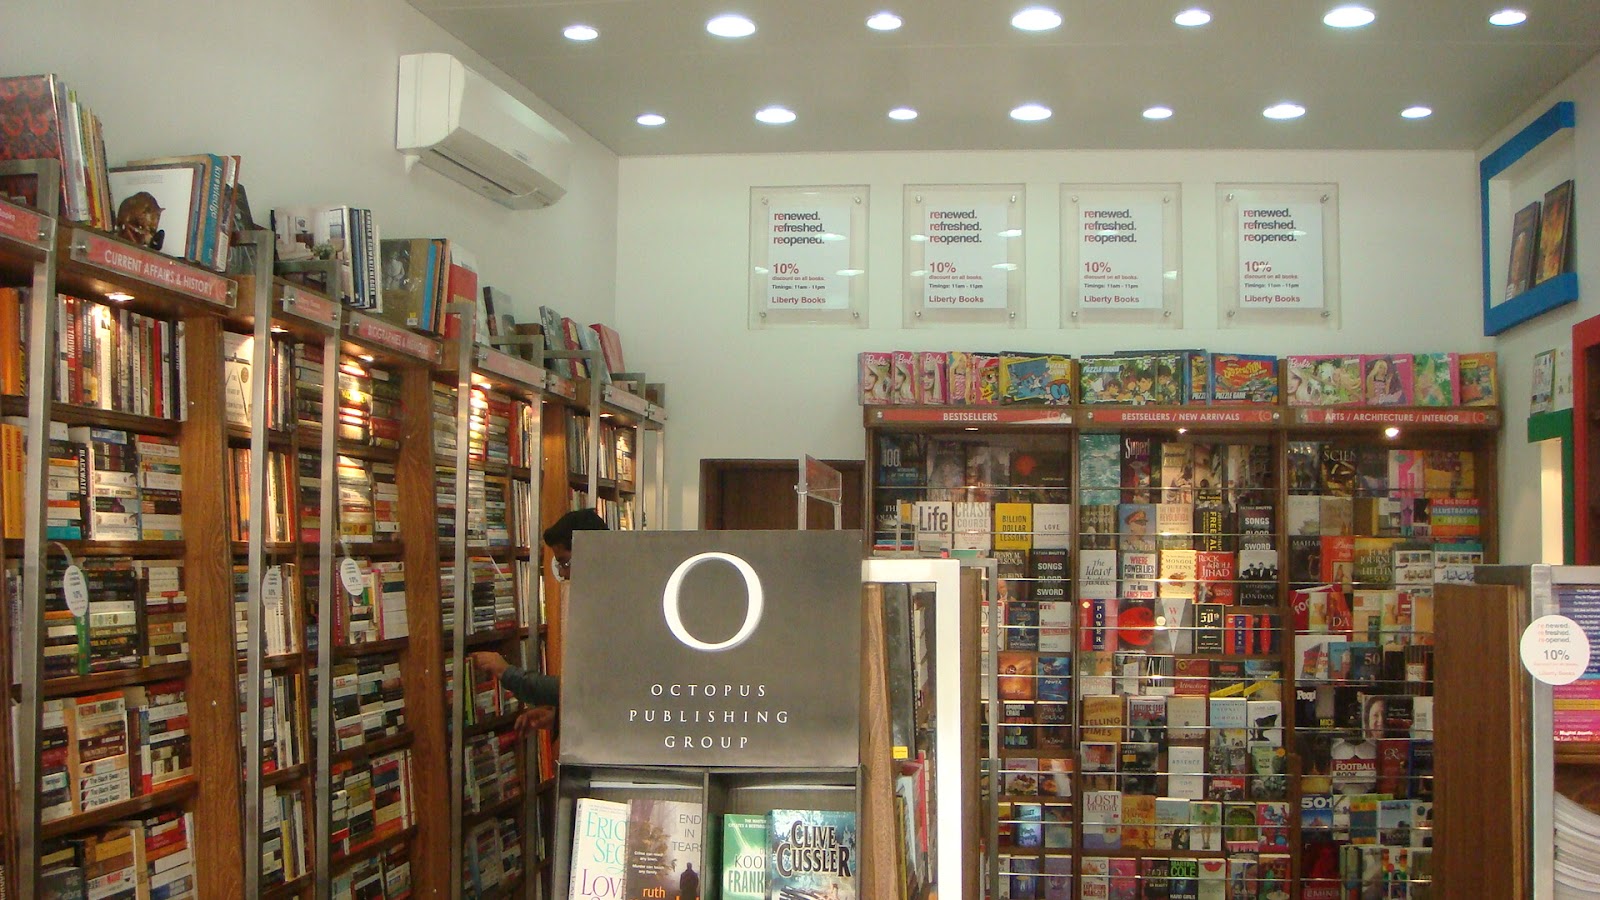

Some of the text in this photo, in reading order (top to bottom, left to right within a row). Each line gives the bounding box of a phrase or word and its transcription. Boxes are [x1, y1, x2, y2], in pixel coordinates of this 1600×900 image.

[774, 211, 820, 221] renewed.
[930, 210, 977, 220] renewed.
[1084, 209, 1132, 218] renewed.
[1244, 208, 1292, 218] renewed.
[774, 223, 825, 232] refreshed.
[930, 222, 982, 232] refreshed.
[1084, 221, 1136, 231] refreshed.
[1244, 220, 1296, 230] refreshed.
[773, 235, 824, 245] reopened.
[930, 234, 982, 244] reopened.
[1084, 233, 1137, 243] reopened.
[1244, 232, 1297, 242] reopened.
[105, 249, 213, 294] CURRENT AFFAIRS & HISTORY
[773, 263, 799, 274] 10%
[930, 262, 956, 273] 10%
[1084, 262, 1112, 273] 10%
[1244, 261, 1272, 272] 10%
[772, 296, 826, 304] Liberty Books
[929, 296, 957, 304] Liberty
[1084, 295, 1140, 304] Liberty Books
[1244, 294, 1300, 303] Liberty Books
[865, 354, 886, 366] Barbie
[926, 353, 944, 364] Barbie
[1289, 358, 1312, 368] Barbie
[1216, 392, 1232, 400] PUZZLE
[943, 412, 998, 421] BESTSELLERS
[1122, 413, 1170, 421] BESTSELLERS
[1179, 413, 1198, 421] NEW
[1200, 413, 1240, 421] ARRIVALS
[1325, 412, 1343, 421] ARTS
[1353, 413, 1413, 422] ARCHITECTURE
[1422, 414, 1459, 422] INTERIOR
[919, 506, 949, 532] Life
[957, 518, 989, 528] COURSE
[1002, 515, 1026, 523] BILLION
[1245, 517, 1270, 525] SONGS
[1002, 524, 1026, 532] DOLLAR
[1000, 534, 1028, 542] LESSONS
[1093, 558, 1105, 567] The
[1130, 556, 1148, 564] WHERE
[1086, 566, 1112, 576] Idea of
[1125, 565, 1155, 573] POWER LIES
[1202, 566, 1230, 578] JIHAD
[1037, 588, 1063, 596] SWORD
[663, 552, 764, 652] O
[1364, 654, 1380, 665] 50
[1544, 650, 1570, 660] 10%
[651, 684, 766, 697] OCTOPUS
[629, 710, 788, 723] PUBLISHING
[1084, 717, 1121, 726] TELLING
[1084, 728, 1112, 736] TIMES
[664, 736, 749, 749] GROUP
[98, 775, 108, 783] Black
[108, 772, 119, 780] Swan
[98, 786, 108, 794] Black
[109, 784, 119, 792] Swan
[98, 797, 108, 805] Black
[109, 794, 119, 802] Swan
[1087, 795, 1119, 805] LOST
[1301, 797, 1333, 808] 501
[679, 814, 702, 824] END
[684, 829, 695, 838] IN
[791, 820, 836, 848] CLIVE
[776, 842, 852, 877] CUSSLER
[1171, 867, 1196, 877] COLE
[582, 868, 624, 898] LOV
[643, 886, 666, 898] ruth
